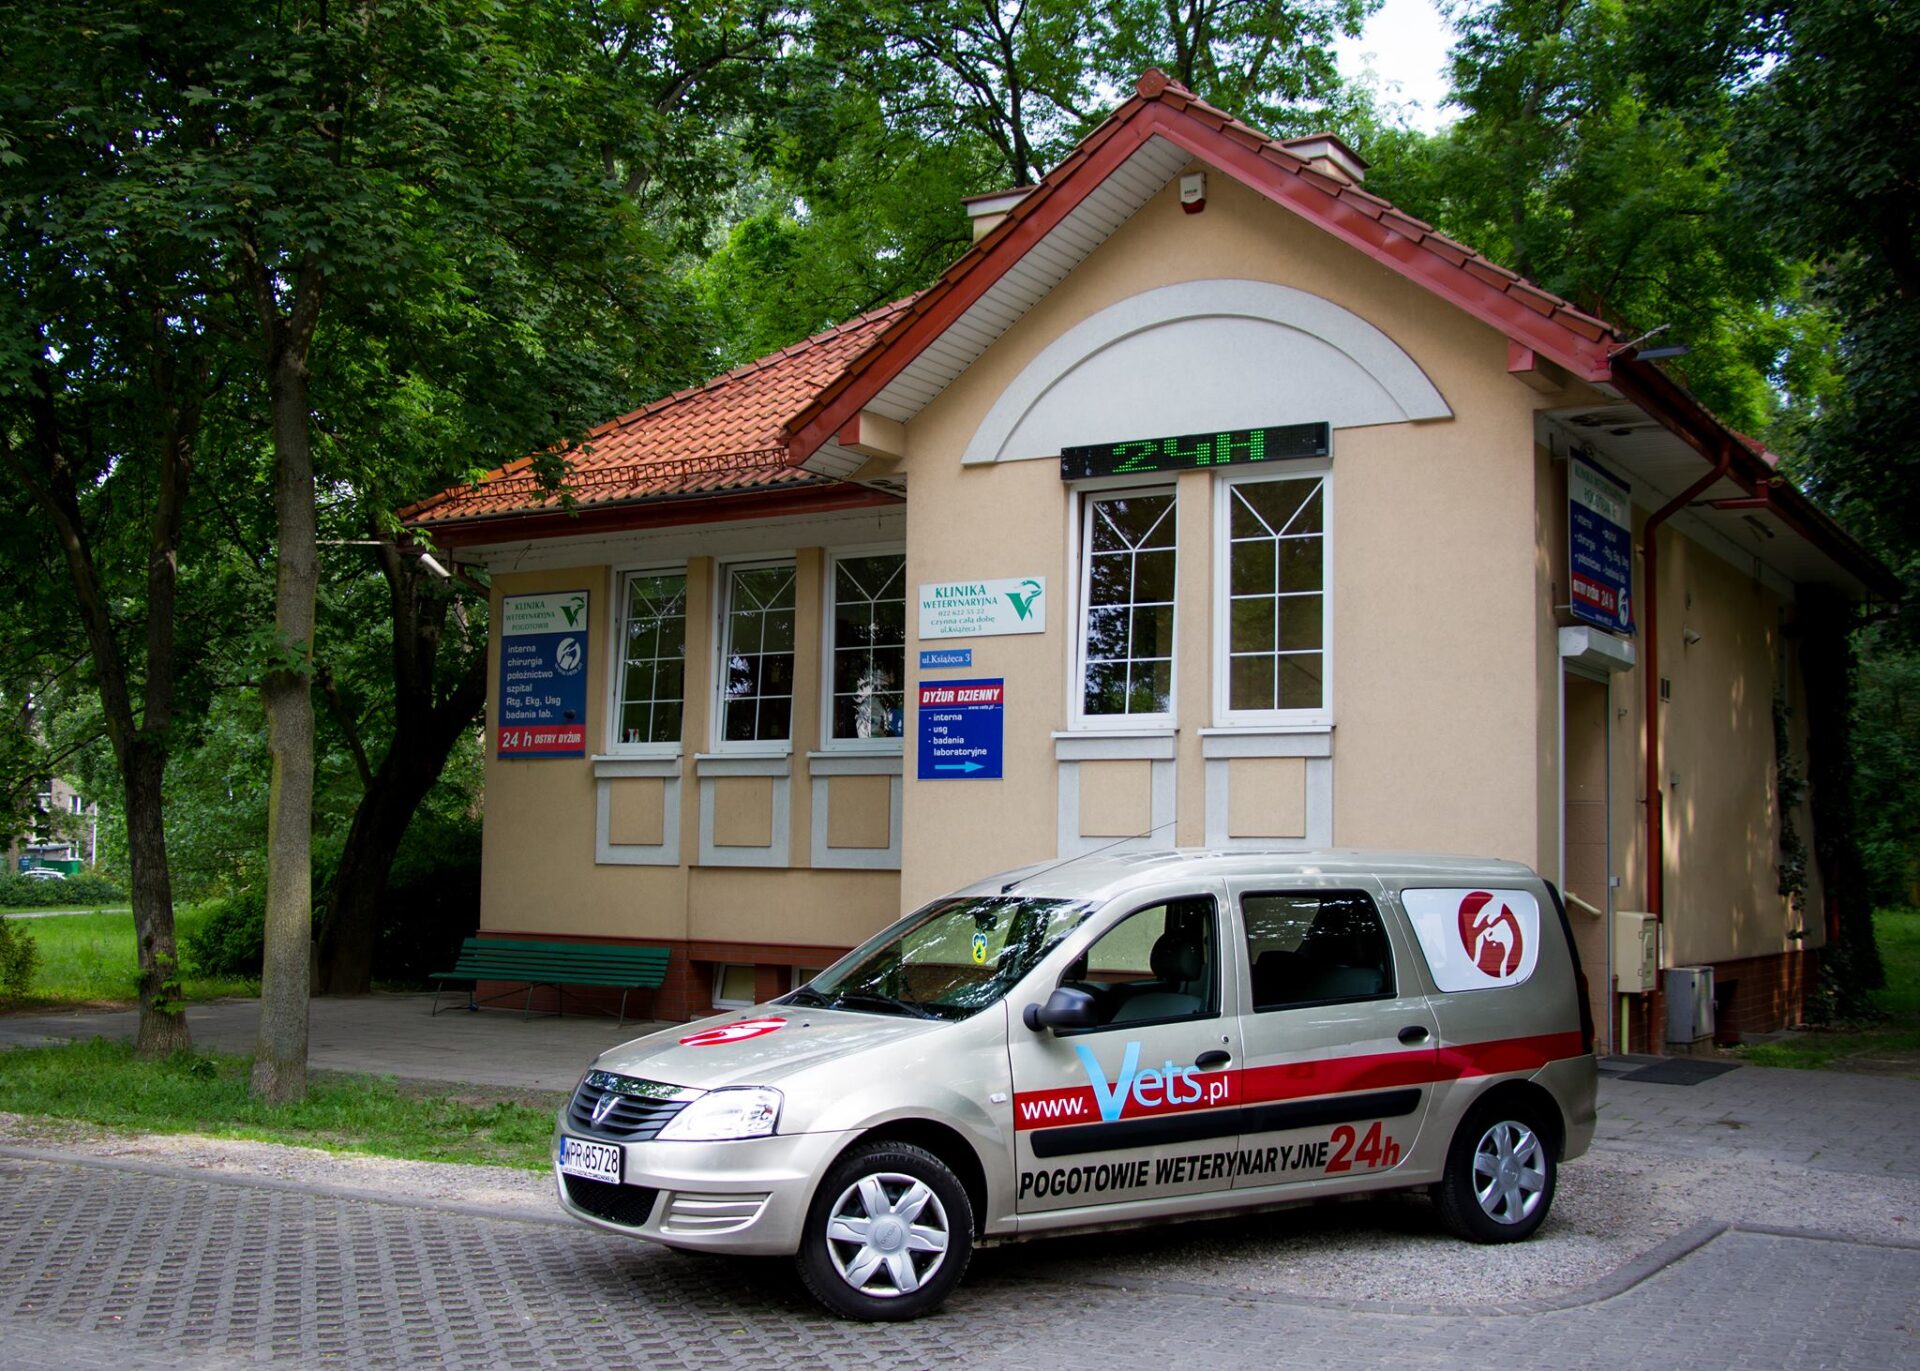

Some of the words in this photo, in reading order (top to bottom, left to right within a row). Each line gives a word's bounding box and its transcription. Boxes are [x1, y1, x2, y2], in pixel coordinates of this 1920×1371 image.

[1112, 431, 1265, 472] 24H
[935, 584, 987, 599] KLINIKA
[515, 600, 545, 610] KLINIKA
[922, 597, 998, 609] WETERYNARYJNA
[506, 611, 556, 622] WETERYNARYJNA
[512, 622, 549, 631] POGOTOWIE
[508, 645, 536, 654] interna
[507, 657, 543, 668] chirurgia
[964, 653, 971, 662] 3
[506, 683, 533, 694] szpital
[545, 695, 561, 707] Usg
[922, 688, 955, 703] DYŻUR
[957, 688, 1000, 702] DZIENNY
[505, 709, 536, 720] badania
[538, 708, 553, 719] lab.
[933, 713, 963, 721] interna
[933, 726, 948, 735] usg
[502, 731, 519, 748] 24
[522, 731, 532, 747] h
[534, 733, 556, 745] OSTRY
[558, 731, 582, 743] DYŻUR
[933, 736, 965, 745] badania
[933, 747, 988, 758] laboratoryjne
[585, 1145, 618, 1174] 85728
[1018, 1160, 1149, 1200] POGOTOWIE
[1154, 1141, 1329, 1185] WETERYNARYJNE
[1324, 1121, 1401, 1174] 24h
